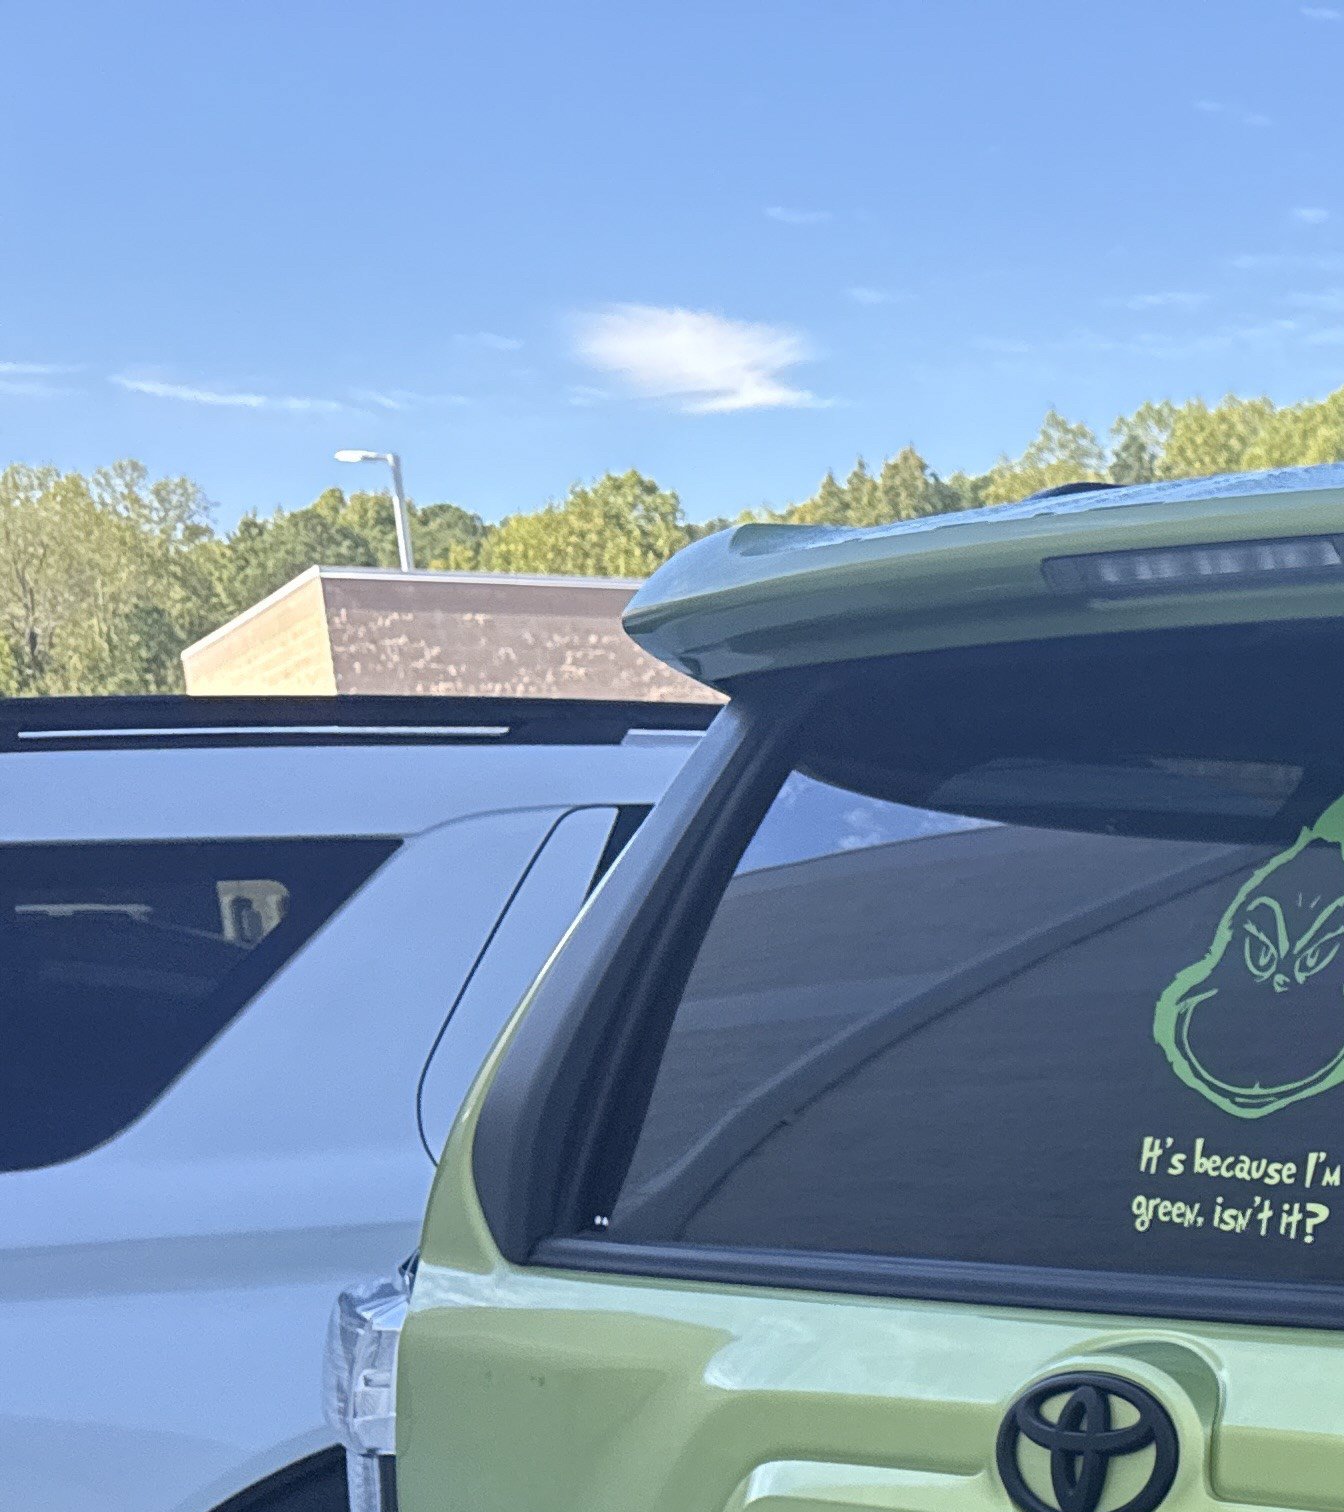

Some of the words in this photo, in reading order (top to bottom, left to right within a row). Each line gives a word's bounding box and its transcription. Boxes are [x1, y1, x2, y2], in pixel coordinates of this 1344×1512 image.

[1139, 1135, 1187, 1176] It's
[1193, 1137, 1297, 1186] because
[1212, 1195, 1273, 1237] isn't
[1279, 1201, 1330, 1244] it?
